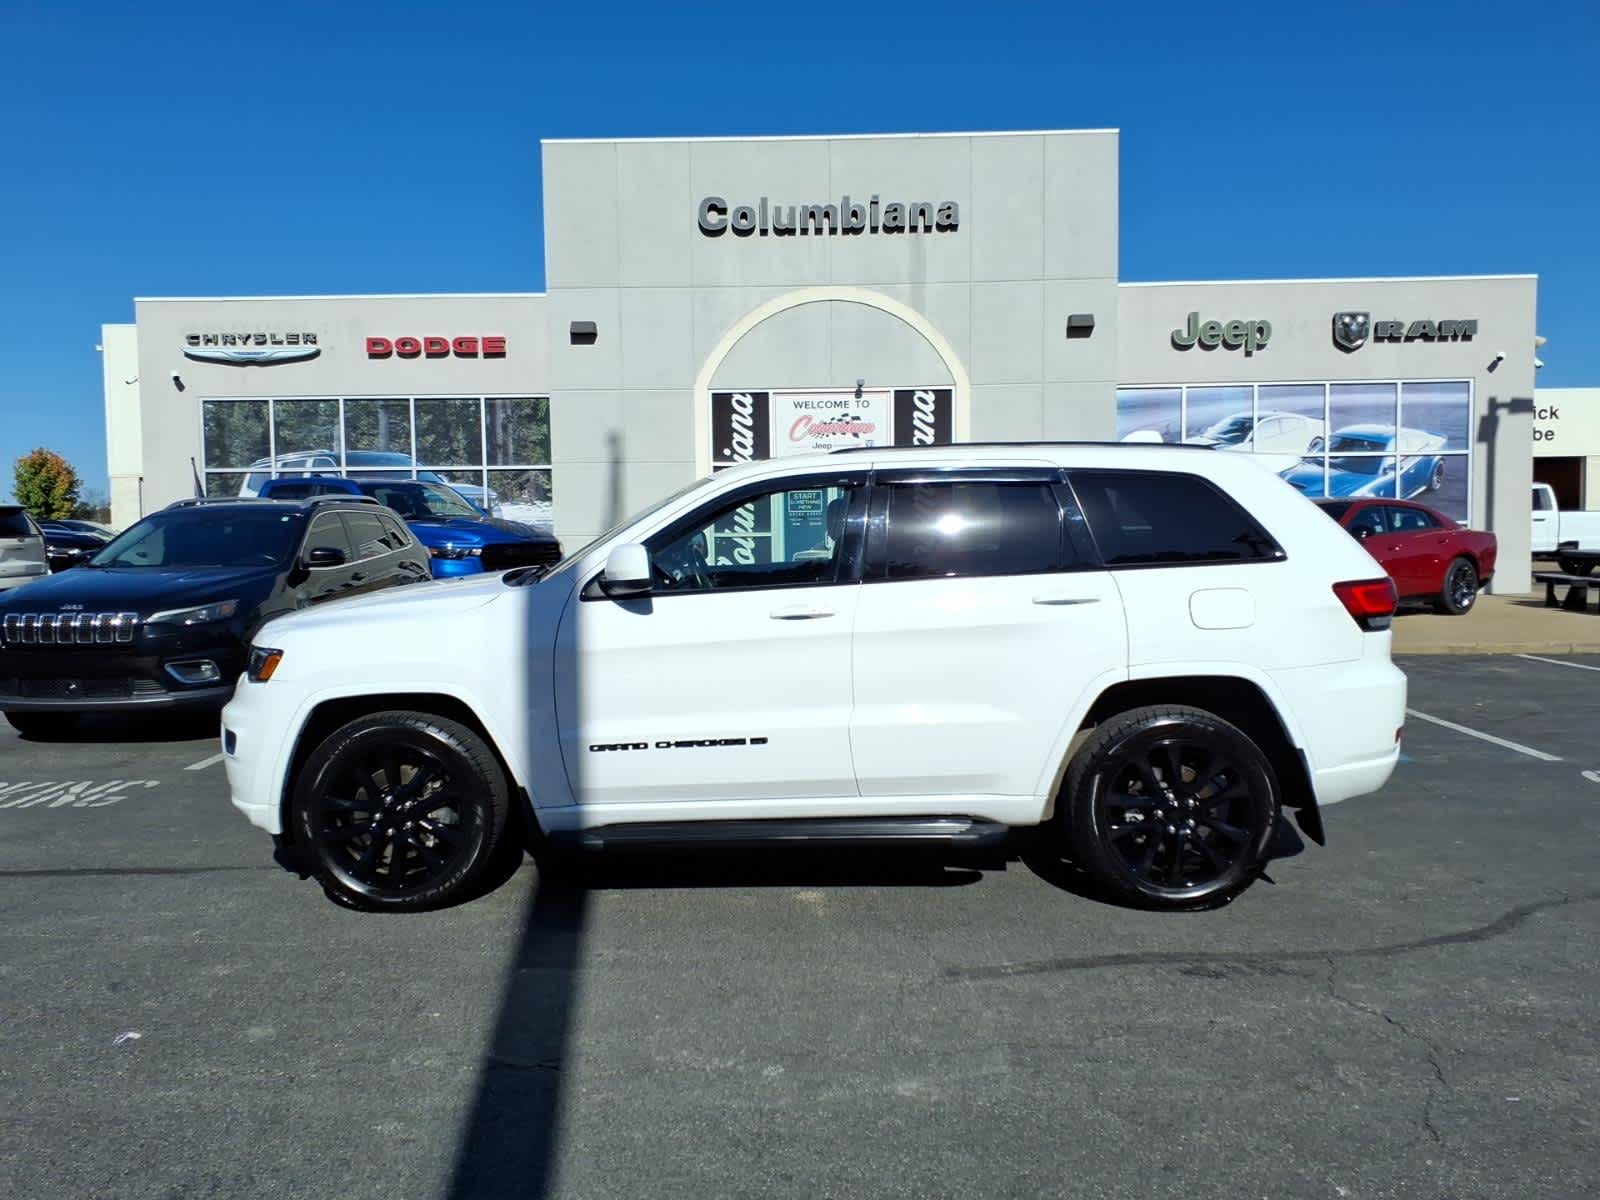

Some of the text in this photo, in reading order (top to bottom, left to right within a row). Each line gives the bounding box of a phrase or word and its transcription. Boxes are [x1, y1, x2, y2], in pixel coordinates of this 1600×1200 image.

[698, 195, 960, 237] Columbiana
[1171, 311, 1273, 357] Jeep
[1373, 319, 1478, 343] RAM
[186, 332, 318, 346] CHRYSLER
[366, 336, 506, 359] DODGE
[793, 400, 870, 409] WELCOME TO
[1532, 427, 1555, 441] be
[812, 442, 833, 450] Jeep
[589, 742, 649, 753] GRAND
